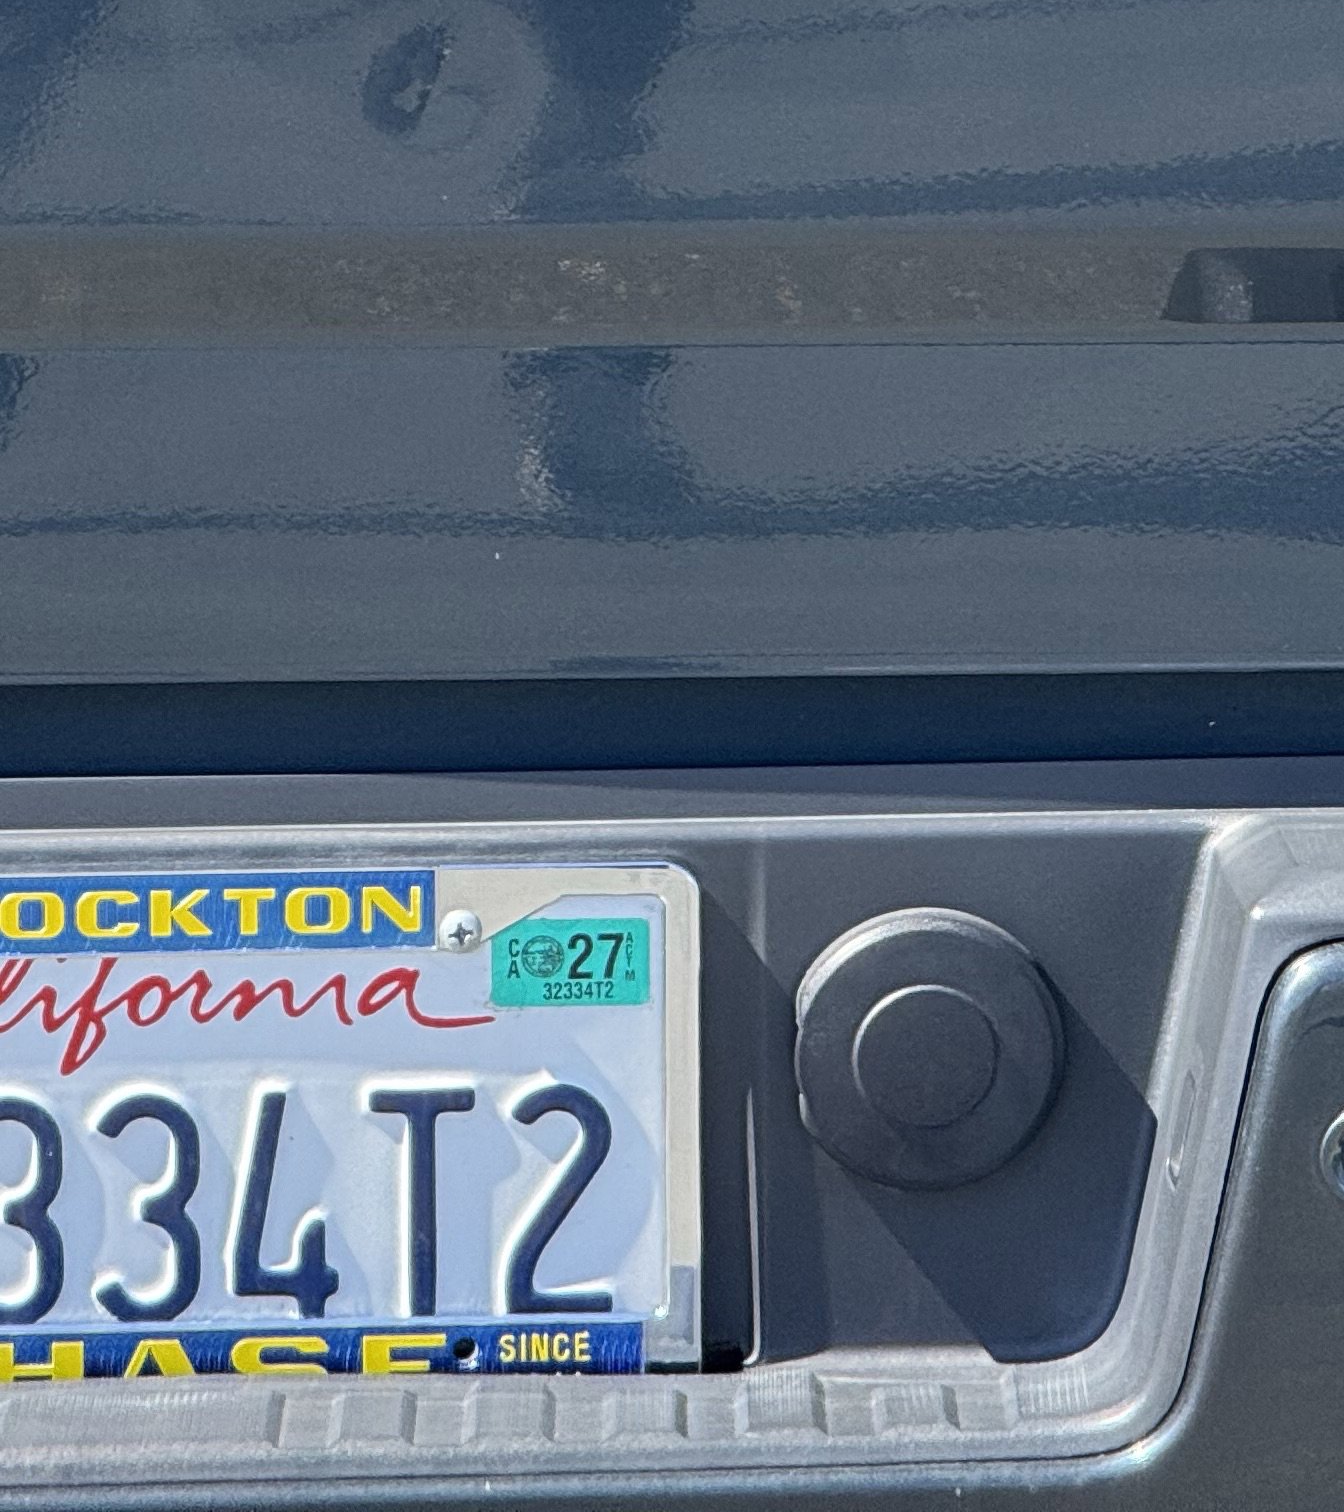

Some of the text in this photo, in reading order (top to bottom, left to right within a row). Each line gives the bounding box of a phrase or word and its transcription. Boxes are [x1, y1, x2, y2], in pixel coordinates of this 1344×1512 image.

[0, 886, 421, 938] OCKTON
[567, 932, 624, 979] 27
[543, 981, 614, 1000] 32334T2
[499, 1331, 591, 1363] SINCE
